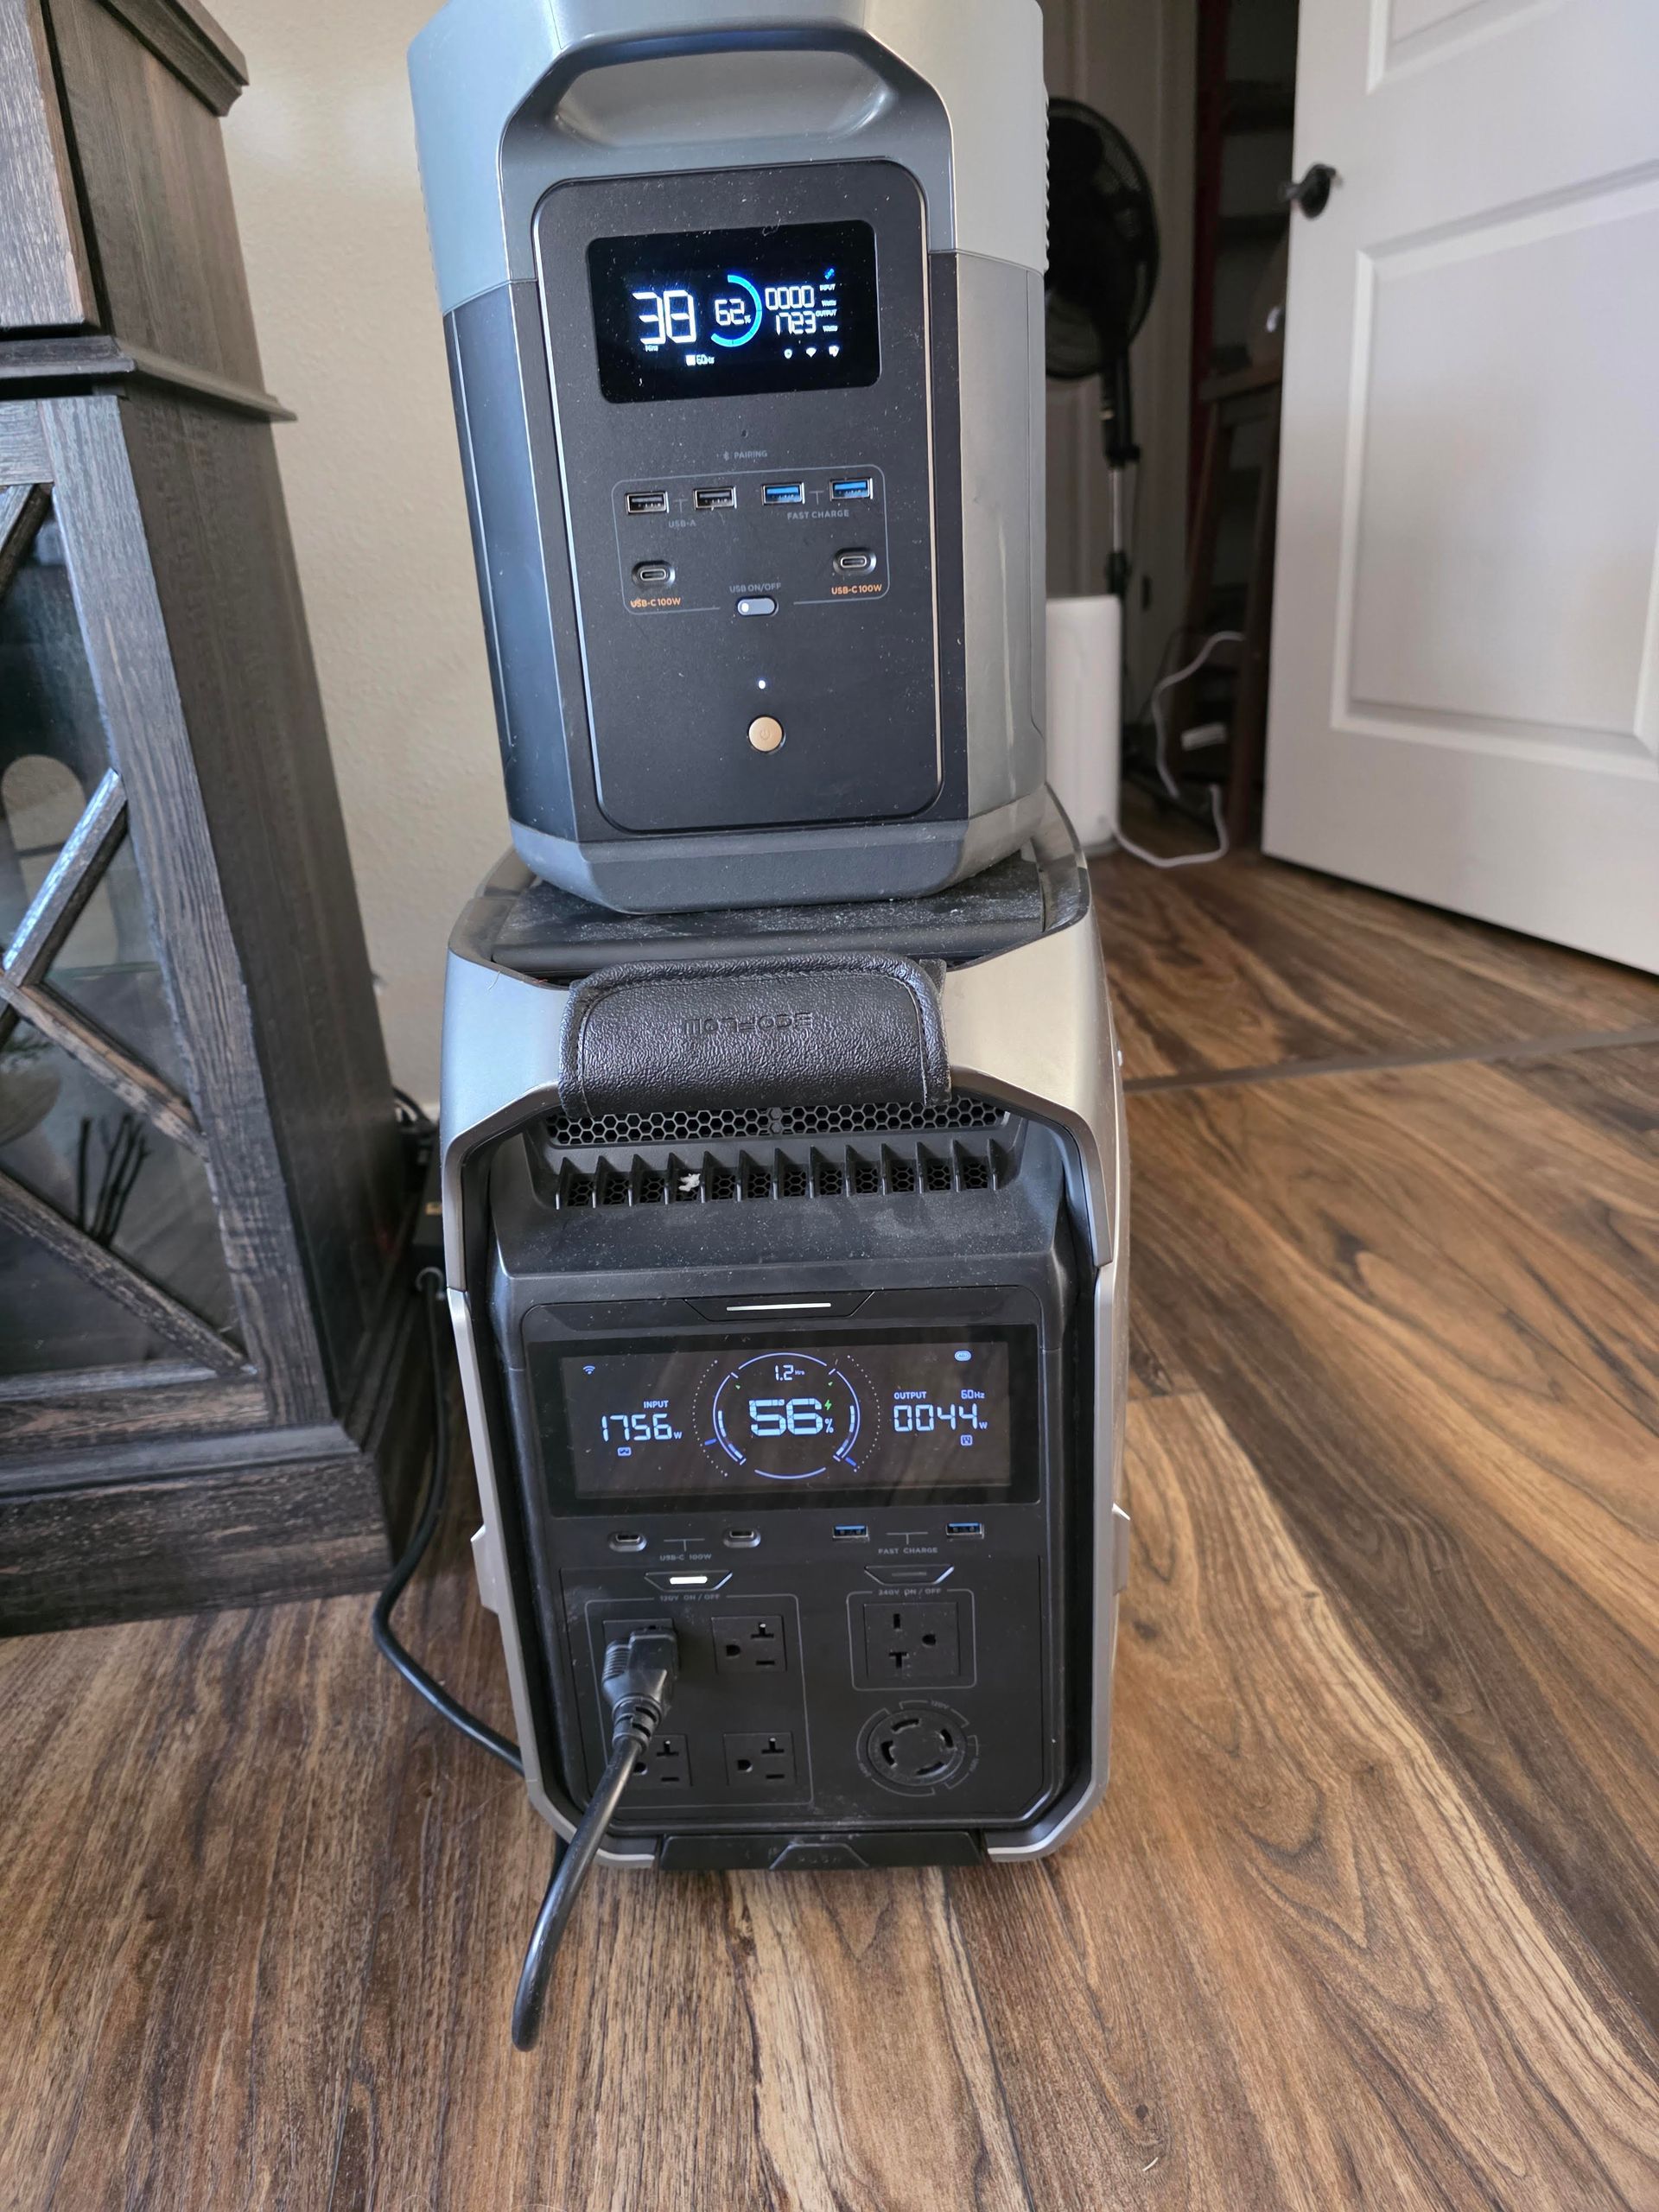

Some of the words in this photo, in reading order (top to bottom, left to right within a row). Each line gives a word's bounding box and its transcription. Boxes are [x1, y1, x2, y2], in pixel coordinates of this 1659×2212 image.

[765, 285, 815, 310] 0000
[632, 289, 697, 345] 38
[776, 310, 817, 335] 1723
[734, 450, 768, 459] PAIRING
[787, 511, 810, 520] FAST
[811, 509, 849, 519] CHARGE
[668, 518, 696, 528] USB-A
[728, 584, 747, 594] USB
[747, 582, 781, 593] ON/OFF
[831, 586, 857, 595] USB-C
[858, 583, 882, 593] 100W
[630, 600, 656, 609] USB-C
[657, 597, 681, 607] 100W
[893, 1390, 927, 1400] OUTPUT
[961, 1389, 985, 1399] 60Hz
[643, 1400, 669, 1408] INPUT
